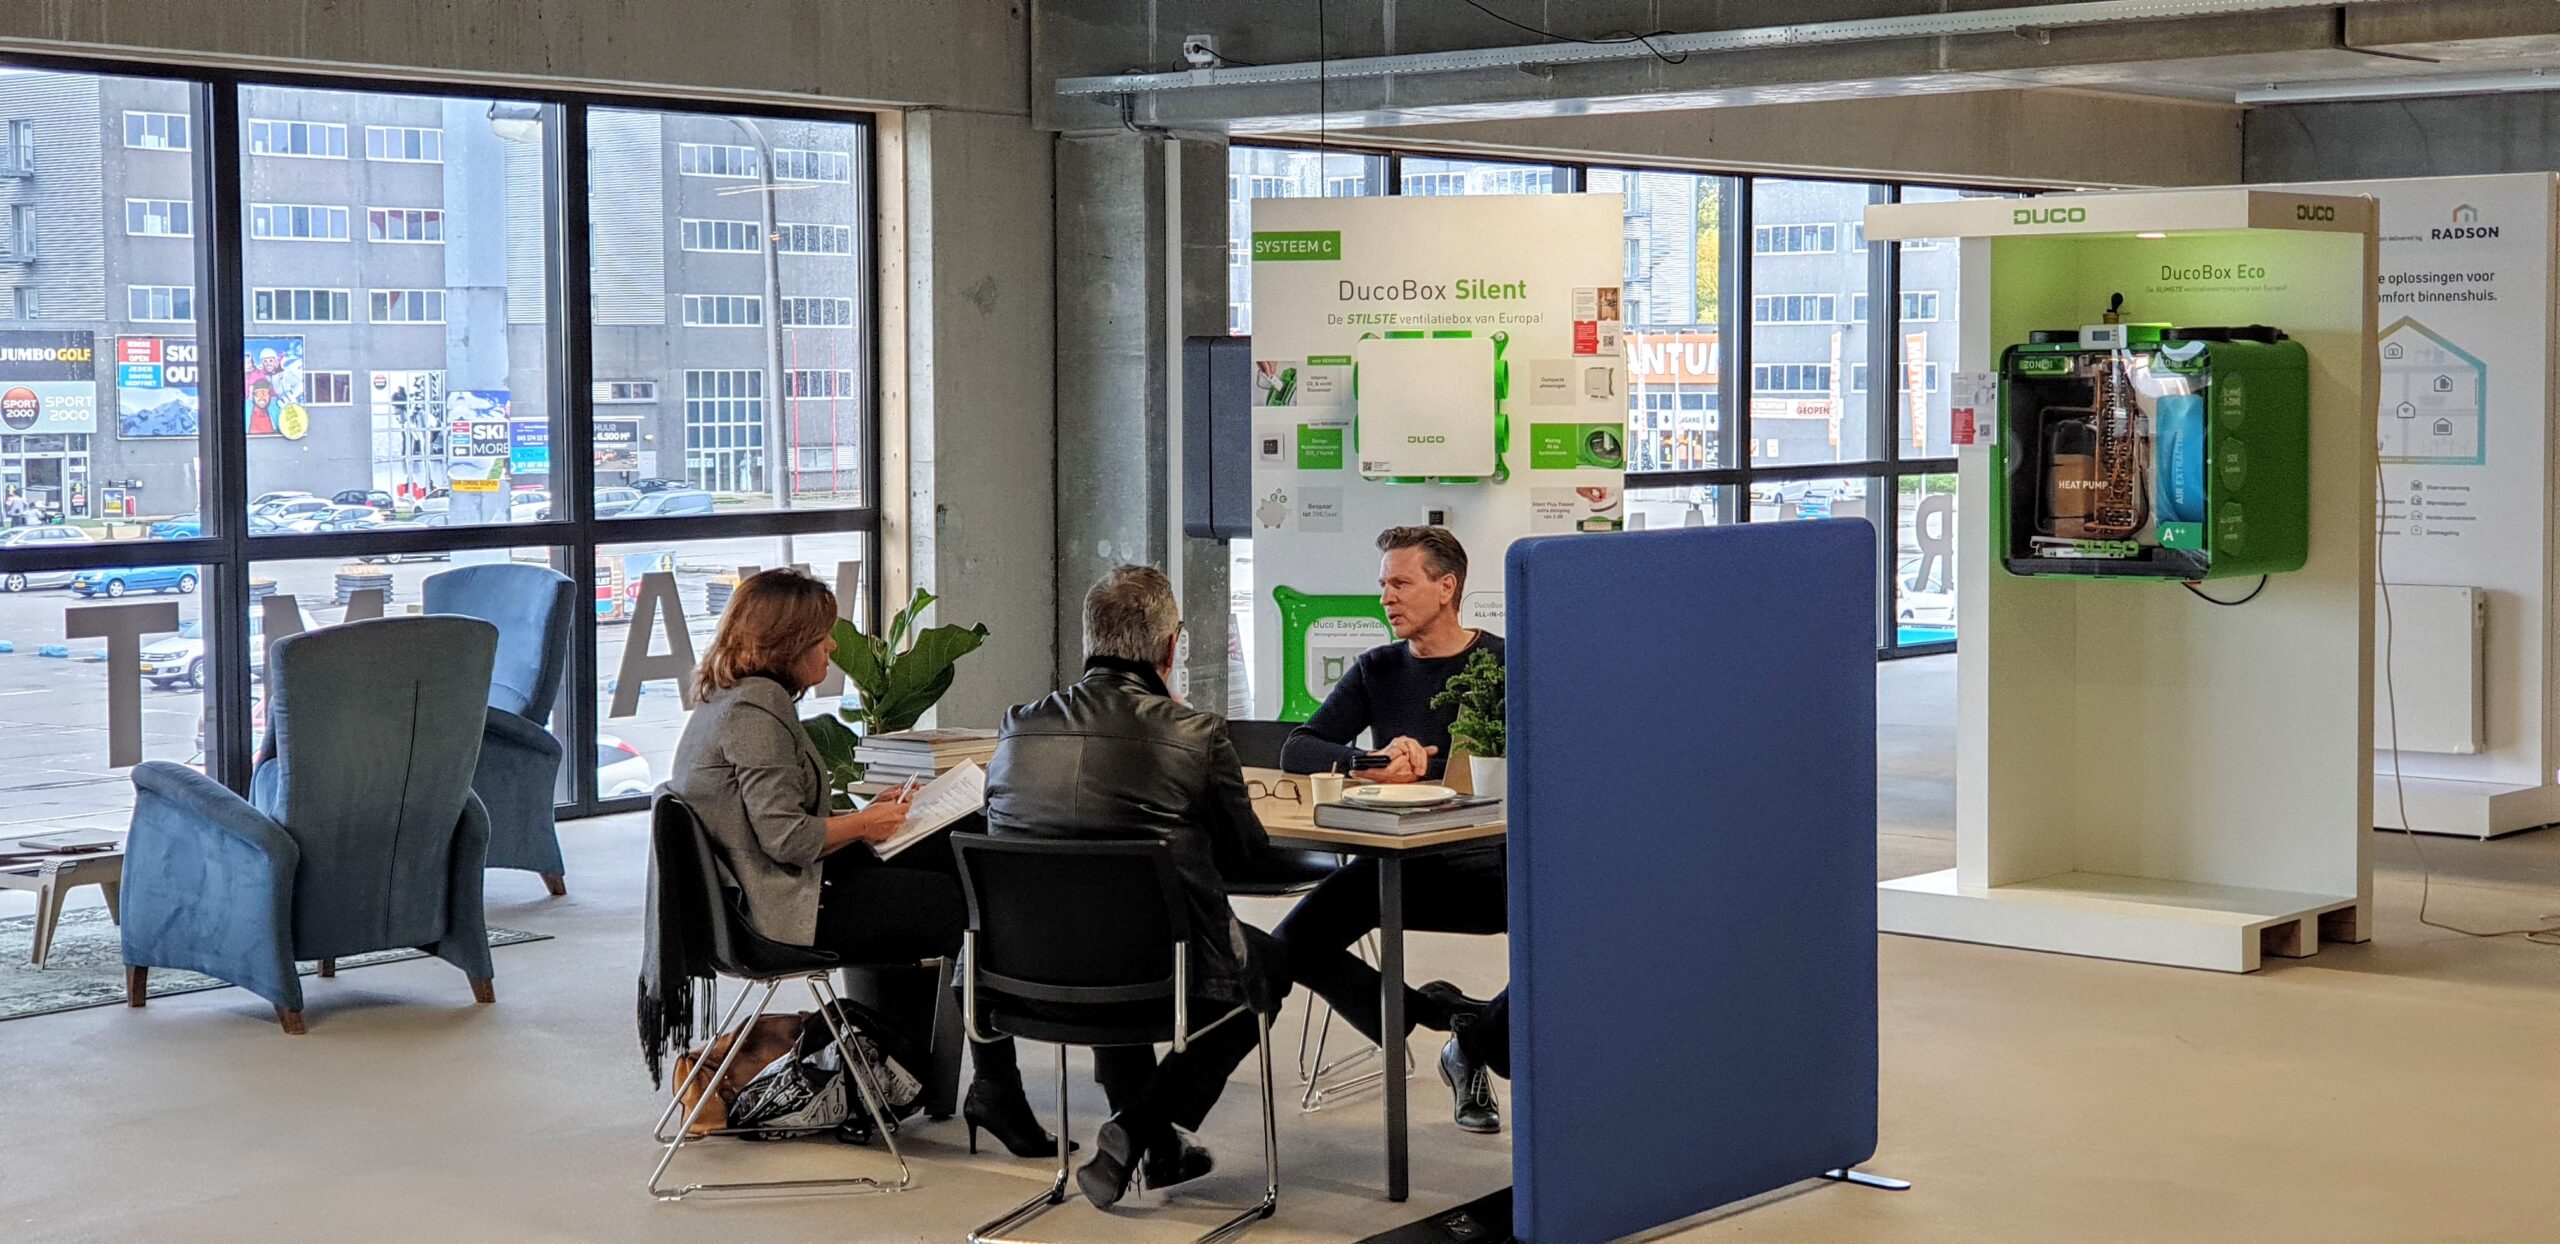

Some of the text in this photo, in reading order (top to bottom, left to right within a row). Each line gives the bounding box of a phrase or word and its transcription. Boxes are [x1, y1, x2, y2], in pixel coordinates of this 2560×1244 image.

[2014, 207, 2086, 225] DUCO
[2297, 204, 2335, 221] DUCO
[2431, 226, 2499, 240] RADSON
[1255, 240, 1332, 253] SYSTEEM C
[2161, 264, 2266, 281] DucoBox Eco
[2388, 271, 2464, 287] oplossingen
[2466, 272, 2495, 282] voor
[1339, 278, 1527, 301] DucoBox Silent
[2418, 289, 2498, 303] binnenshuis.
[1327, 312, 1544, 326] De STILSTE ventilatiebox van Europa!
[166, 345, 198, 362] SKI
[3, 399, 37, 409] SPORT
[45, 396, 93, 408] SPORT
[6, 409, 35, 418] 2000
[50, 409, 89, 421] 2000
[473, 423, 504, 441] SKI
[473, 443, 509, 455] MORE
[2058, 480, 2109, 489] HEAT PUMP
[2175, 488, 2184, 505] AIR
[1313, 620, 1385, 630] Duco EasySwitch
